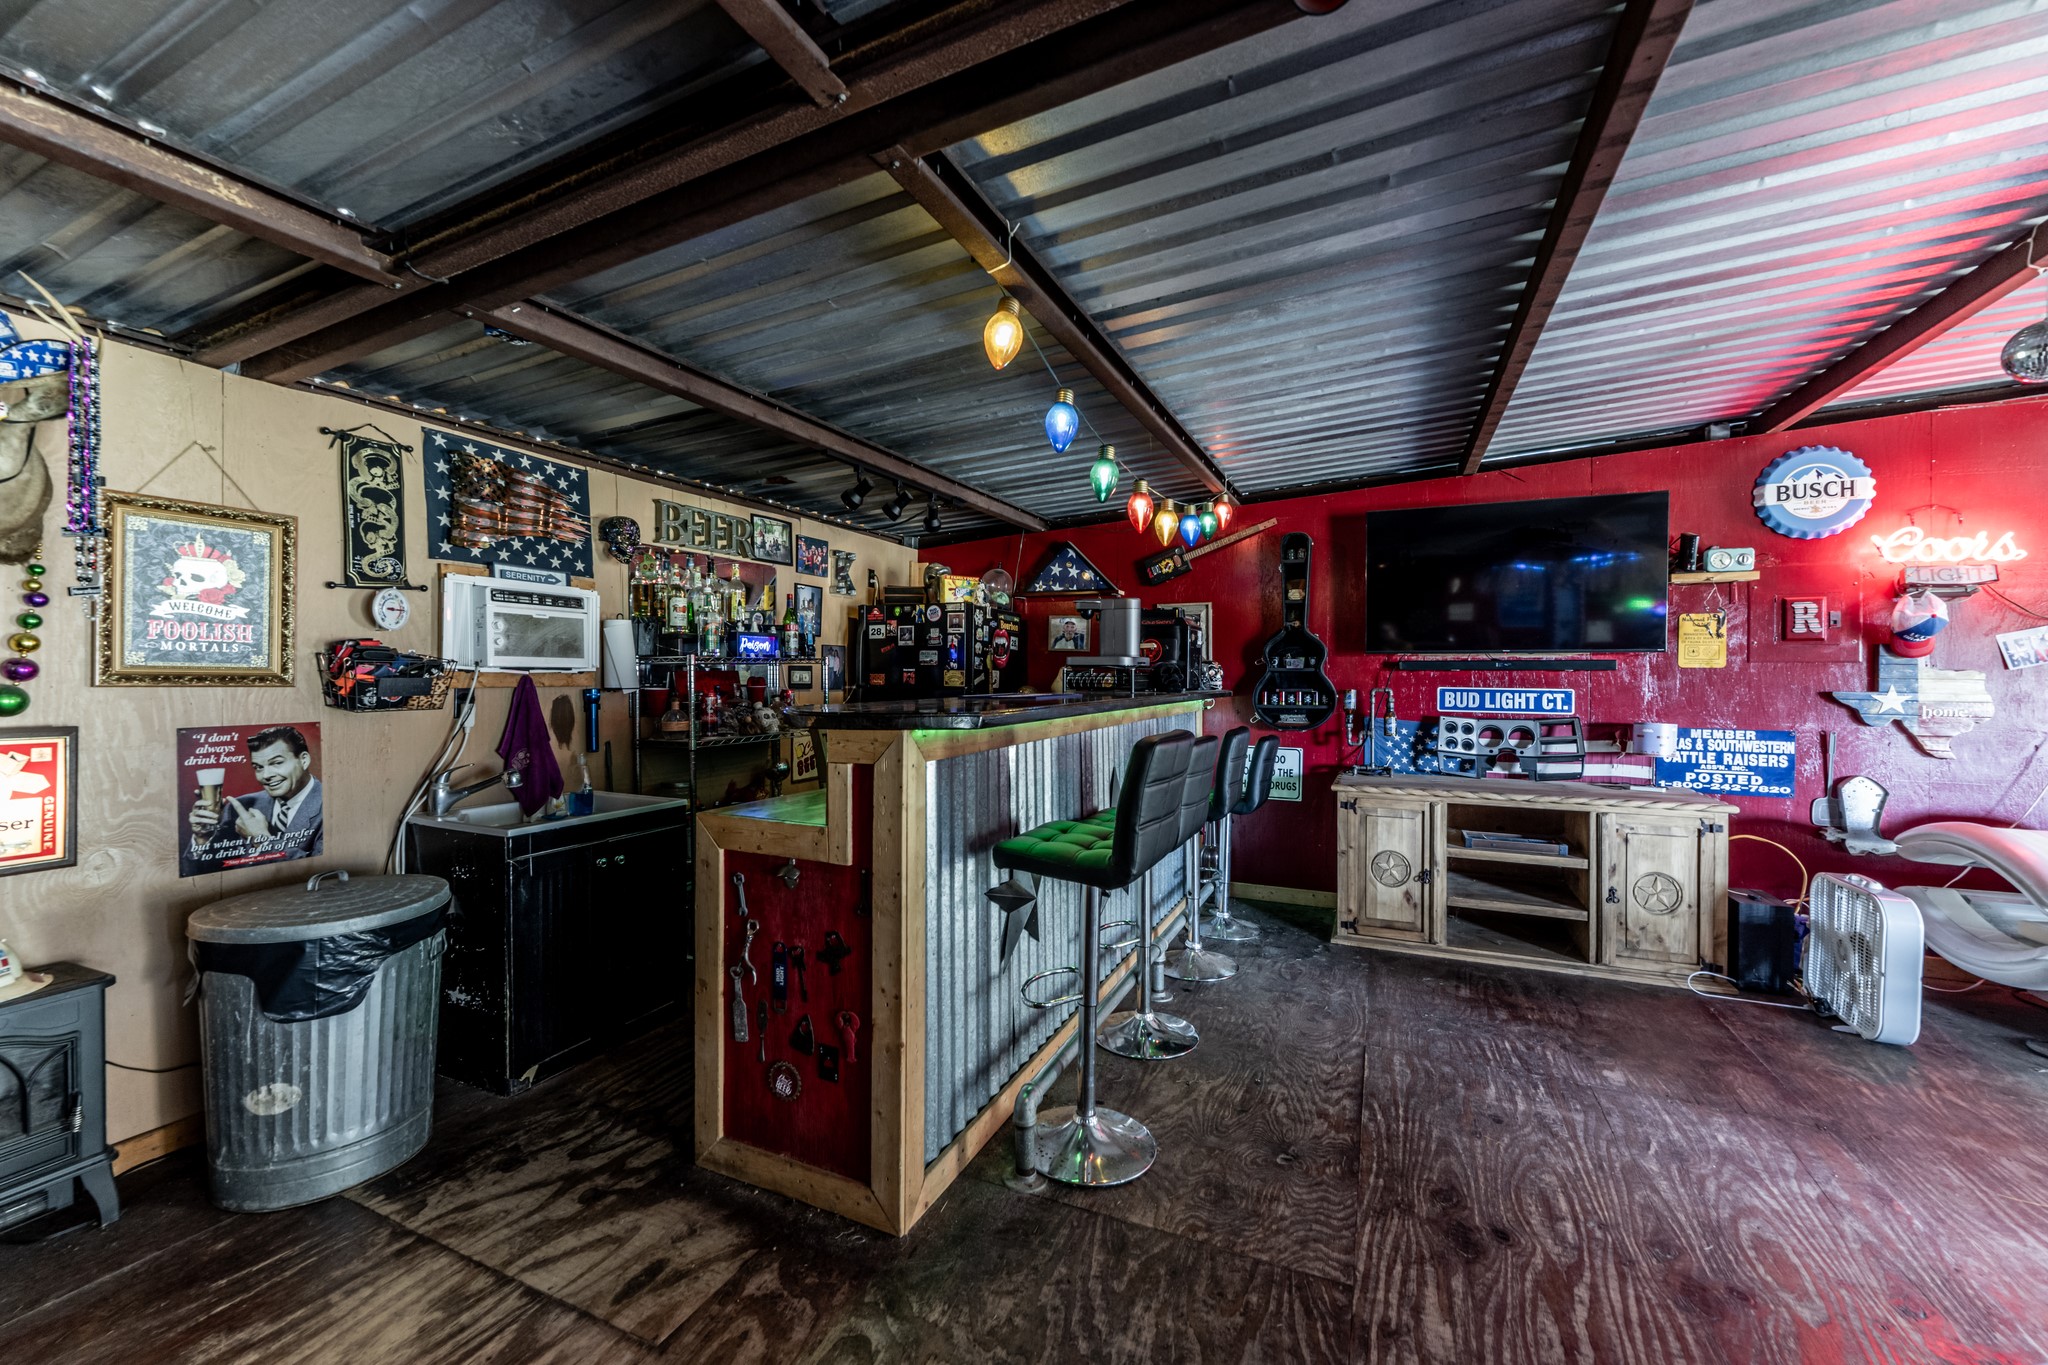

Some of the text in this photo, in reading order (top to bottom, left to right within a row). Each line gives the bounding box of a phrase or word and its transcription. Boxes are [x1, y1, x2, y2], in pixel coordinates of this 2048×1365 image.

[1776, 479, 1855, 502] BUSCH
[652, 498, 757, 560] BEER
[1870, 526, 2029, 562] Coors
[505, 571, 546, 583] SERENITY
[828, 548, 857, 596] K
[1916, 567, 1987, 582] LIGHT
[168, 601, 232, 619] WELCOME
[1791, 601, 1824, 633] R
[146, 619, 254, 643] FOOLISH
[870, 627, 885, 638] 28,
[1000, 619, 1019, 632] Bourbon
[159, 641, 240, 653] MORTALS
[739, 637, 771, 652] Poison
[1444, 692, 1569, 711] BUD LIGHT CT.
[1921, 705, 1973, 719] home.
[207, 732, 239, 743] don't
[1690, 728, 1757, 740] MEMBER
[195, 744, 236, 756] always
[1695, 740, 1704, 751] &
[1707, 739, 1796, 755] SOUTHWESTERN
[184, 753, 247, 766] drink beer,
[1723, 753, 1789, 768] RAISERS
[1277, 768, 1294, 778] THE
[1685, 772, 1764, 786] POSTED
[1270, 781, 1297, 791] DRUGS
[1658, 780, 1792, 794] 1-800-242-7820
[43, 795, 55, 850] GENUINE
[190, 841, 210, 853] but
[213, 836, 243, 848] when
[245, 835, 253, 845] I
[284, 828, 315, 839] prefer
[201, 851, 213, 861] to
[215, 847, 246, 859] drink
[259, 842, 273, 853] lot
[274, 841, 286, 852] of
